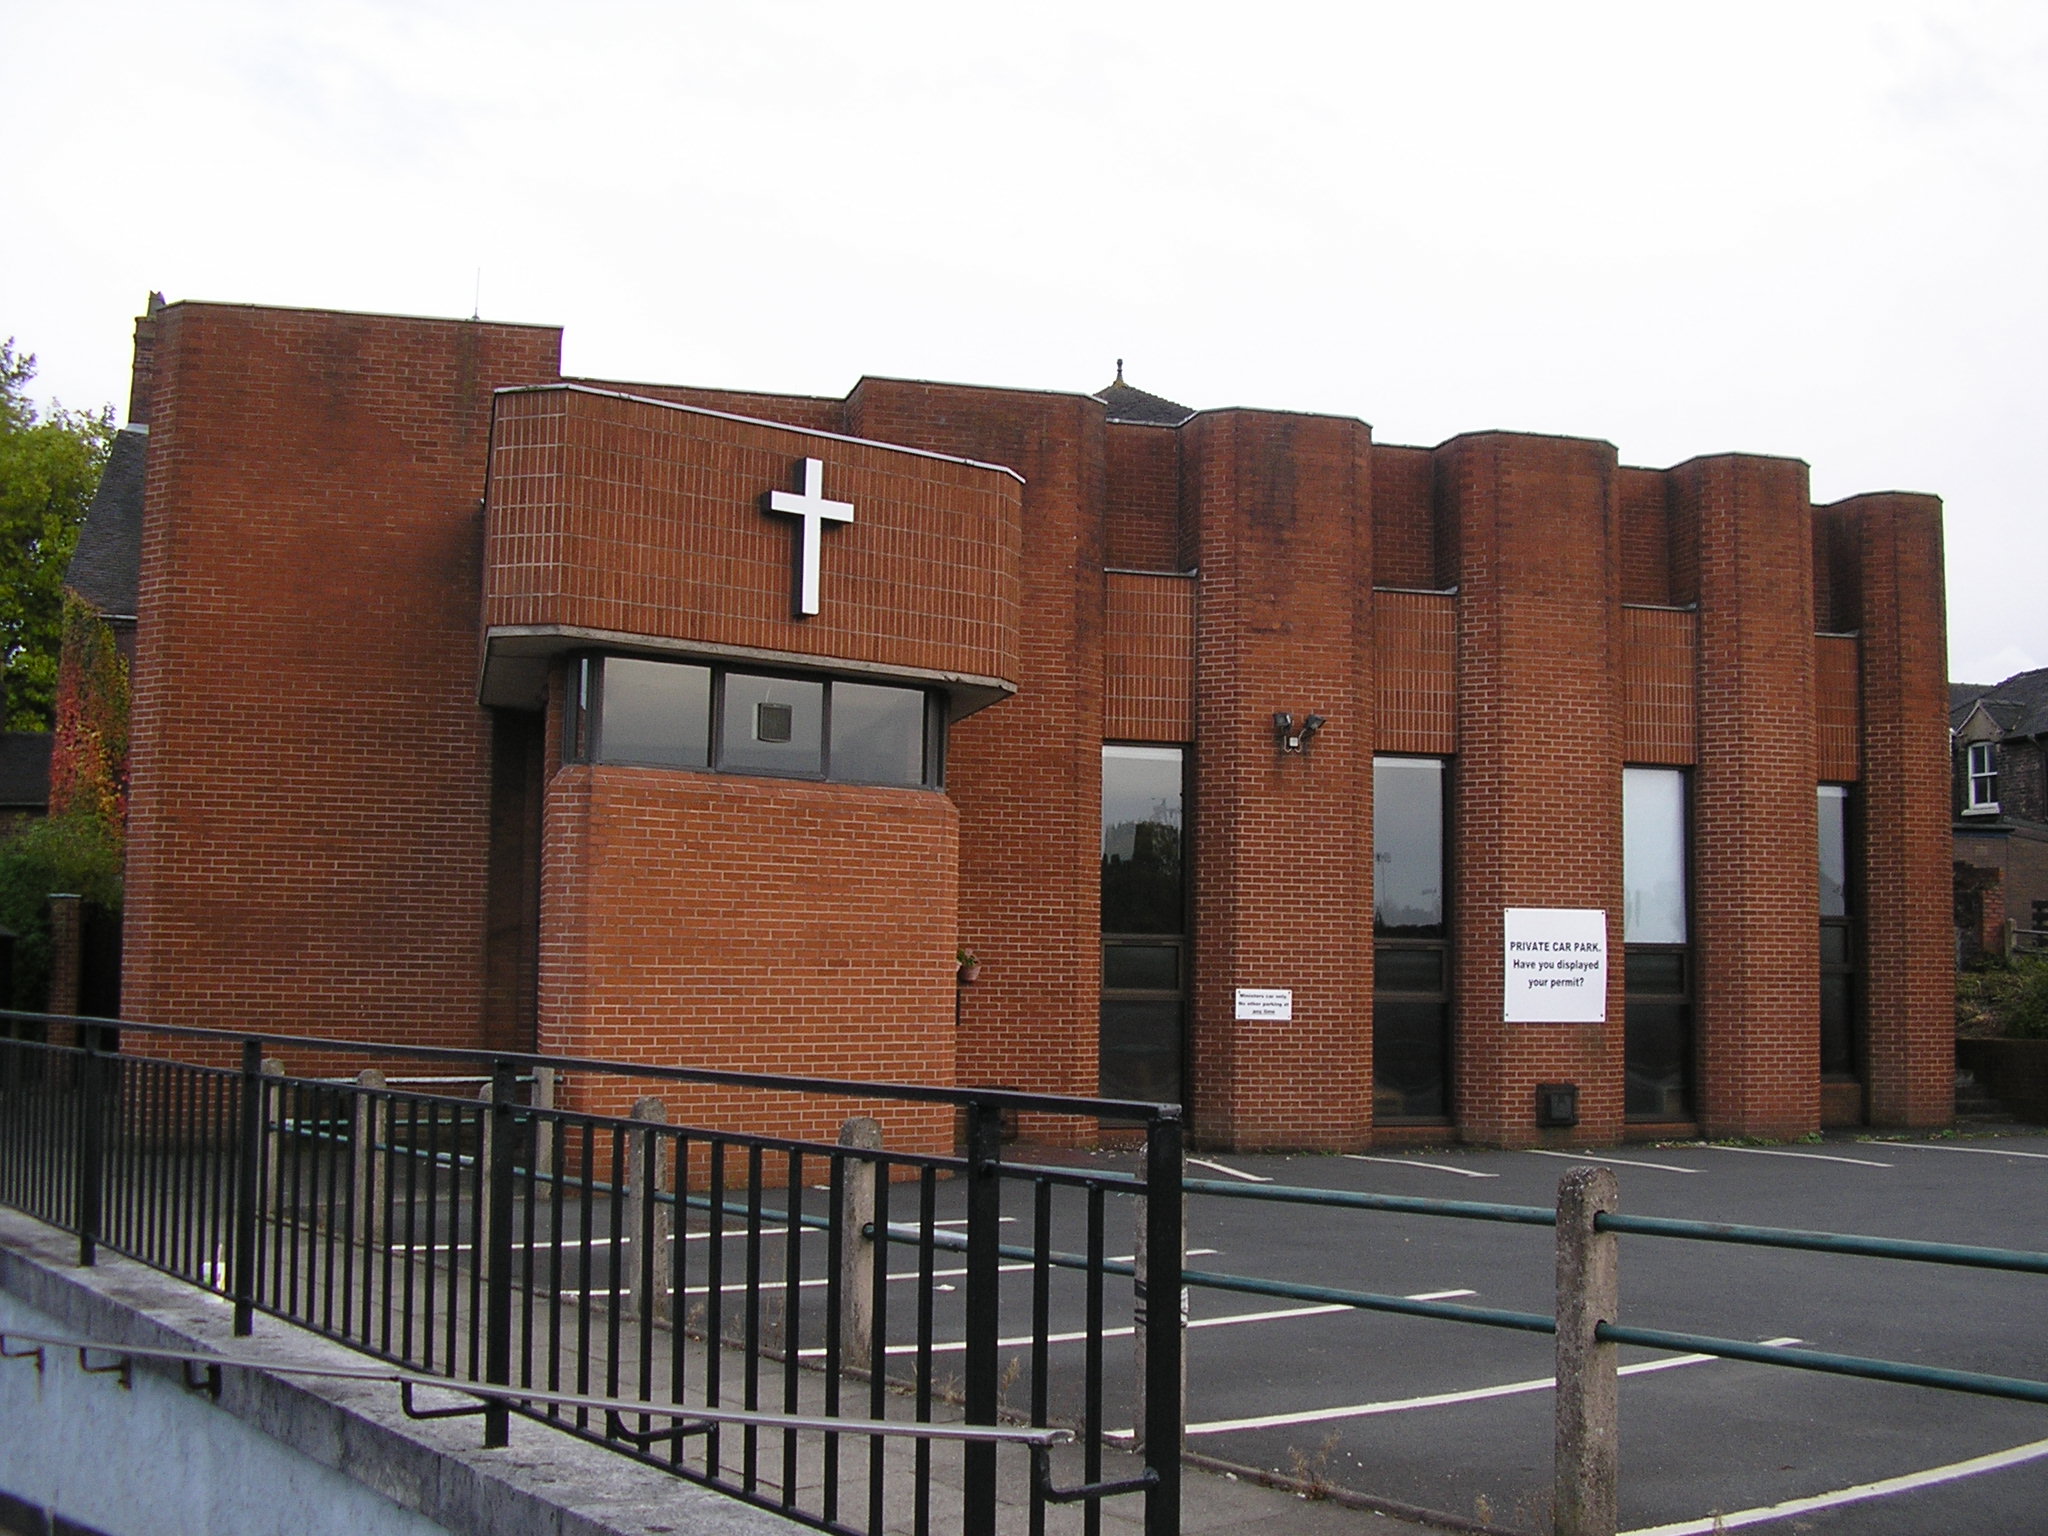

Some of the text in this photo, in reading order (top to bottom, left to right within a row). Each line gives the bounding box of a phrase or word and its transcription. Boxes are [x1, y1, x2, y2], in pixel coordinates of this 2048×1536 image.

[1510, 941, 1602, 953] PRIVATE CAR PARK.
[1513, 958, 1599, 972] Have you displayed
[1528, 977, 1585, 989] your permit?
